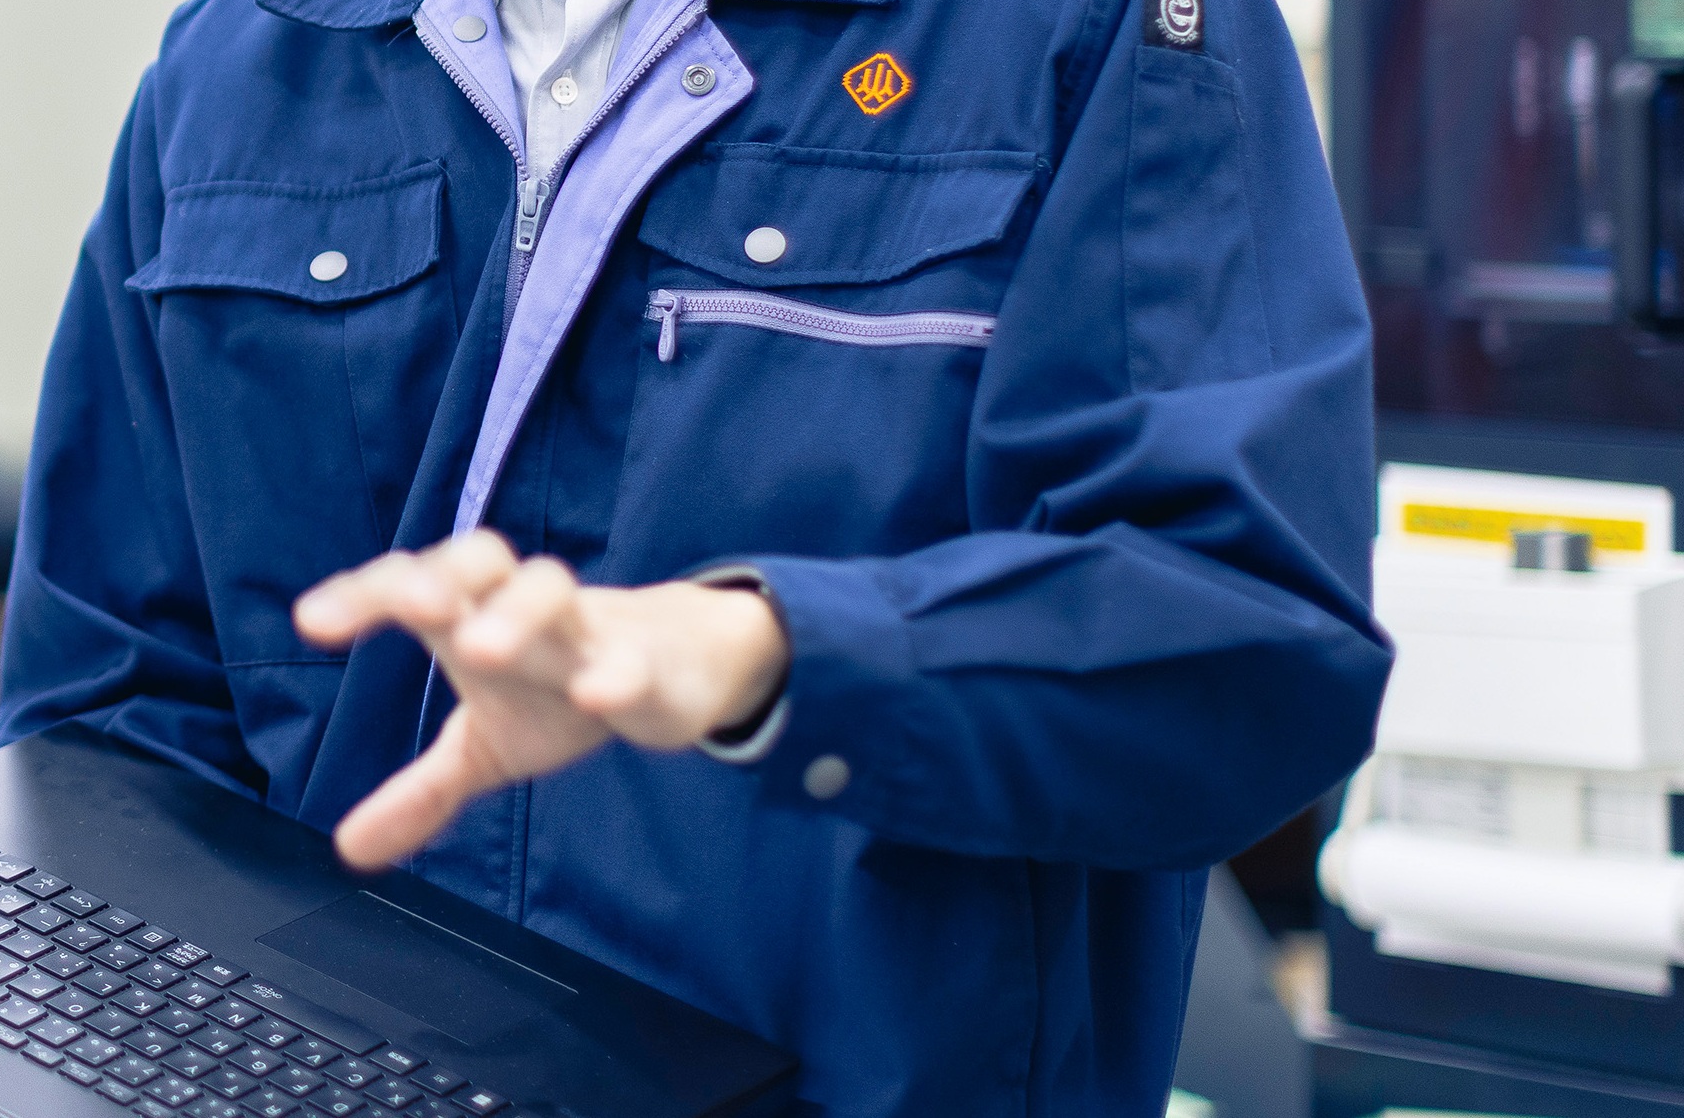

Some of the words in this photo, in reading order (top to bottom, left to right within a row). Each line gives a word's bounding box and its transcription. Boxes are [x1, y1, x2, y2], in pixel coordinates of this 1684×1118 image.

[109, 915, 126, 925] Ctrl
[31, 987, 47, 995] P
[187, 993, 206, 1004] M
[68, 1004, 84, 1013] O
[134, 1001, 151, 1012] K
[227, 1013, 245, 1024] N
[65, 1026, 78, 1034] 9
[268, 1033, 284, 1043] B
[145, 1044, 162, 1054] U
[211, 1040, 229, 1051] H
[306, 1054, 321, 1063] V
[183, 1065, 199, 1075] Y
[251, 1060, 267, 1070] G
[347, 1073, 364, 1083] C
[224, 1085, 239, 1096] T
[291, 1084, 309, 1093] F
